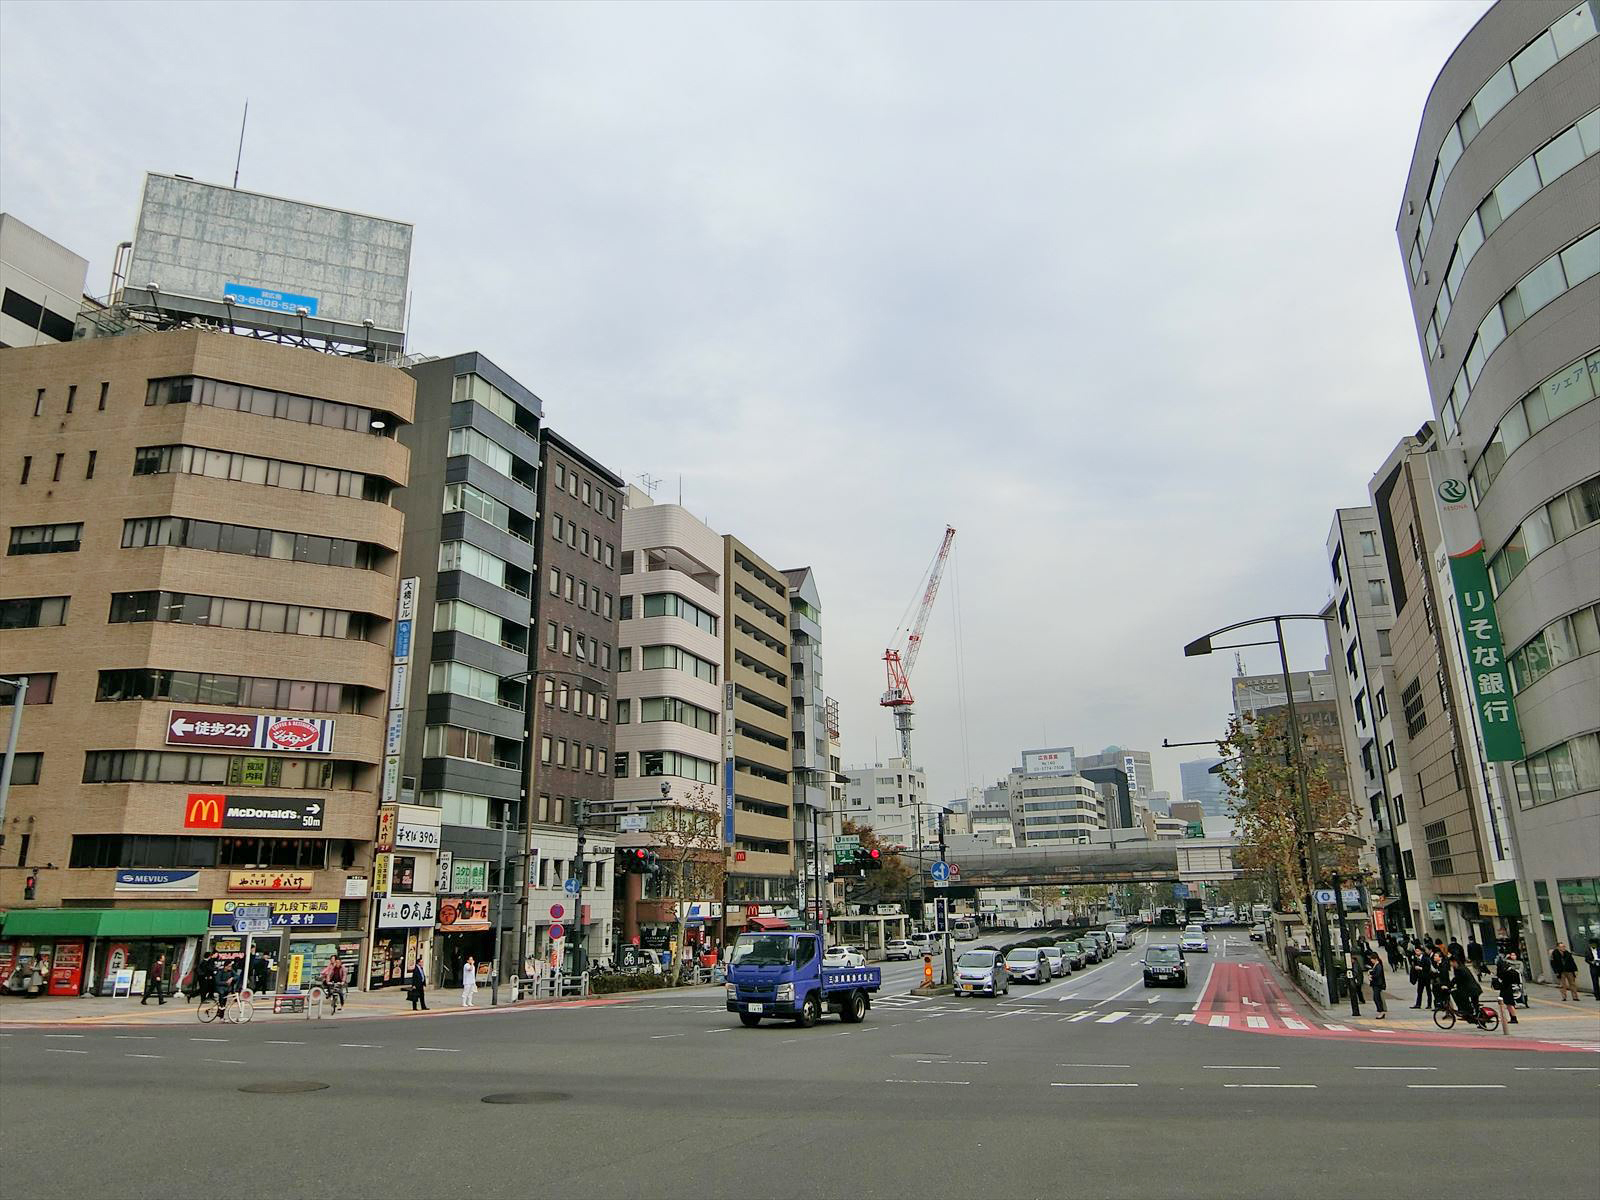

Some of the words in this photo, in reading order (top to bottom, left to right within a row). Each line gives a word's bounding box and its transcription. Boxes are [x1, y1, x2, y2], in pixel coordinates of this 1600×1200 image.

[1464, 590, 1510, 724] りそな銀行
[194, 721, 252, 738] 徒歩2分
[302, 816, 320, 826] 50m
[400, 901, 433, 920] 日高屋
